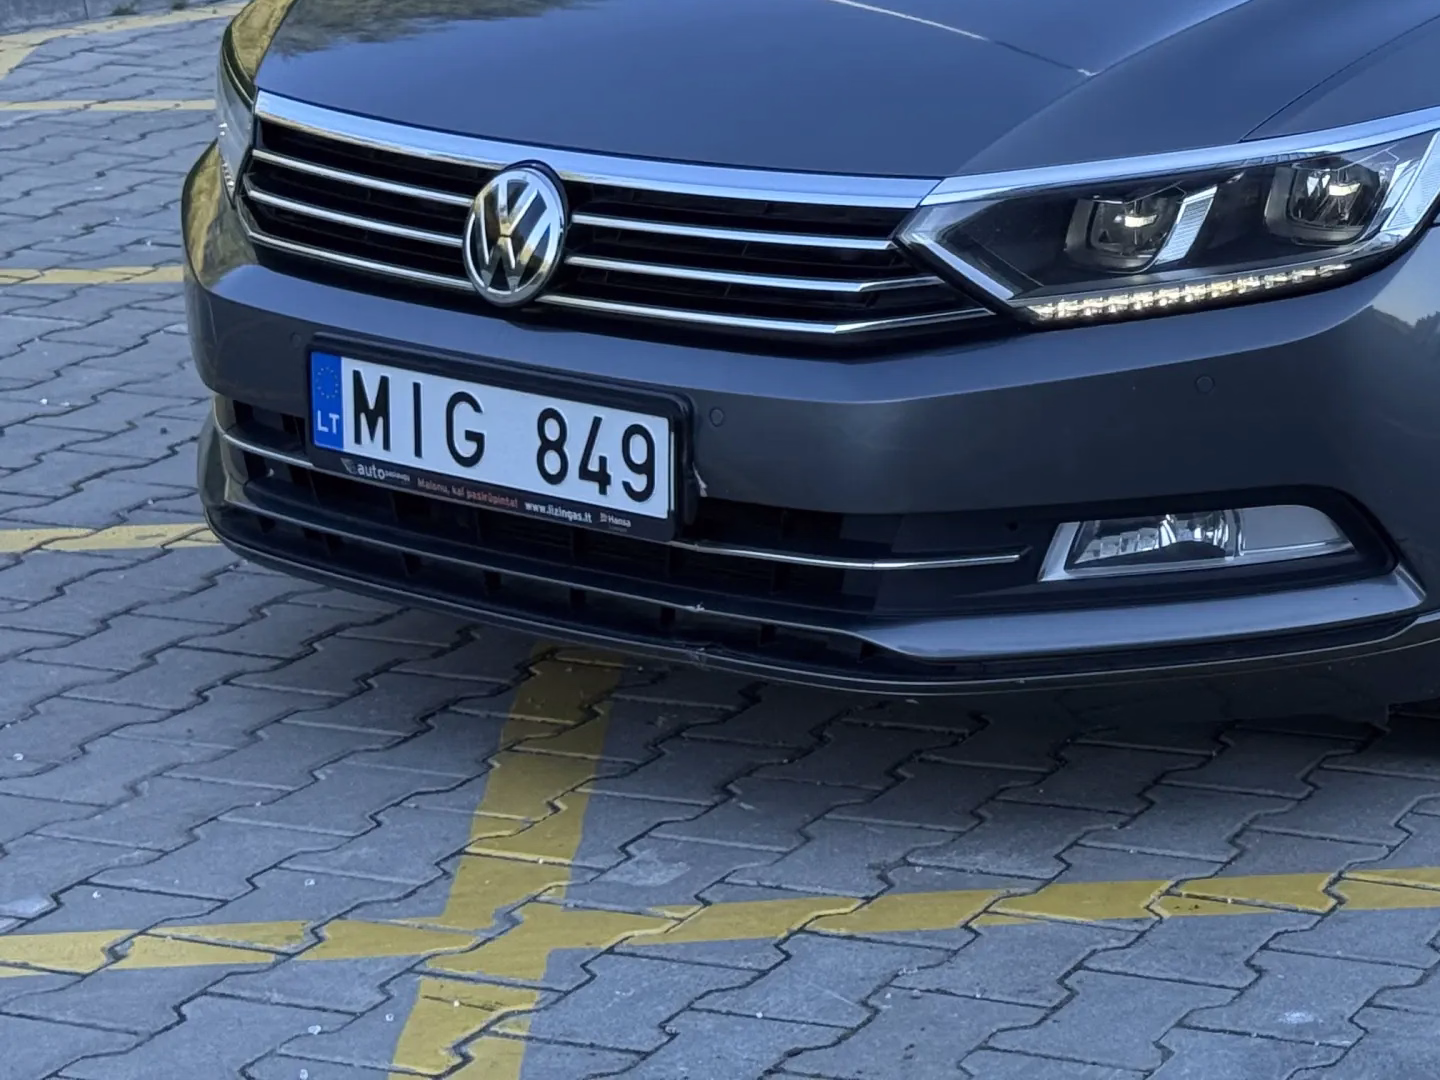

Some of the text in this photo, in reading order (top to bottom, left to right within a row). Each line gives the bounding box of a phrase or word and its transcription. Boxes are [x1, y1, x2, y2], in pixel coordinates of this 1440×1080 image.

[317, 410, 340, 433] LT
[353, 369, 657, 503] MIG 849
